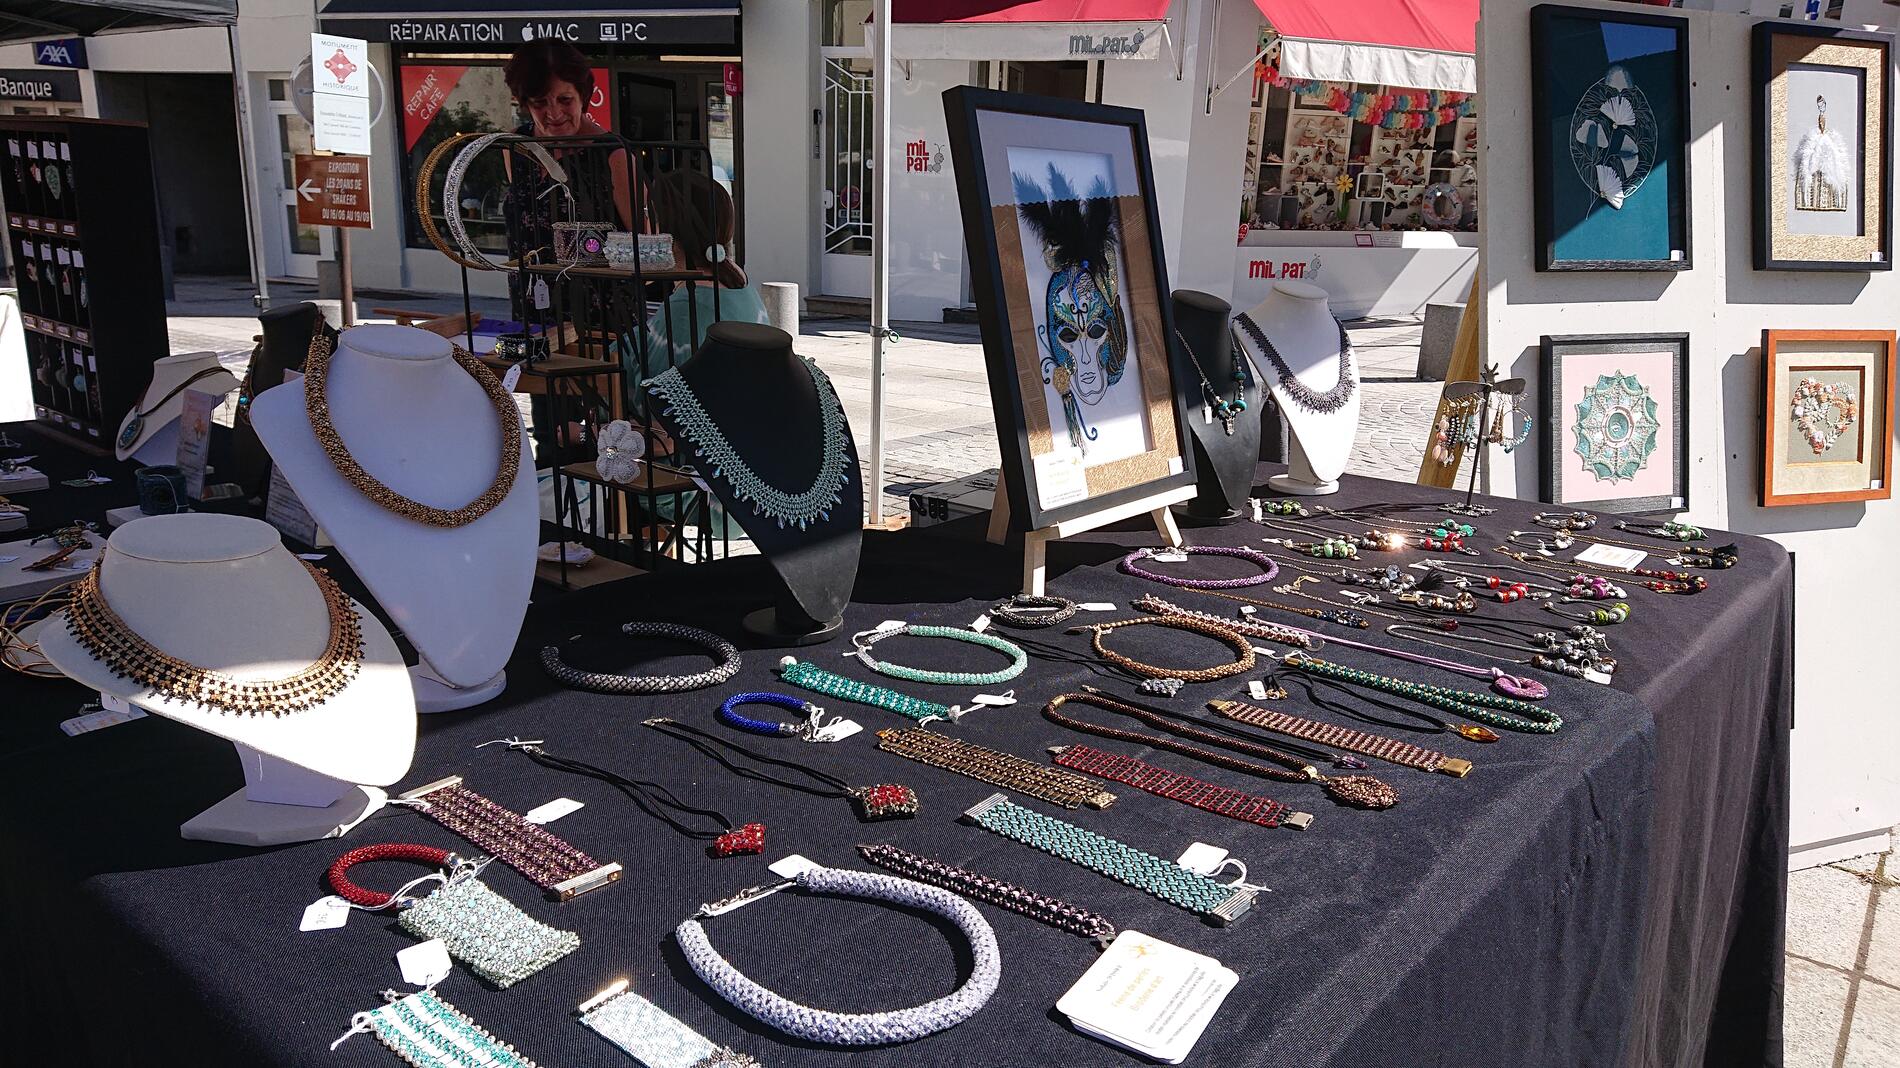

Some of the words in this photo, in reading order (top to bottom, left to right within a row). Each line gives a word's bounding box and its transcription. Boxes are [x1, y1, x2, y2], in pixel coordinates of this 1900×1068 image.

[390, 20, 503, 41] RÉPARATION
[538, 23, 579, 41] MAC
[622, 23, 648, 41] PC
[39, 45, 72, 64] AXA
[0, 77, 52, 100] Banque
[328, 162, 360, 174] EXPOSITION
[326, 177, 335, 188] LES
[343, 179, 353, 190] ANS
[354, 179, 362, 190] DE
[332, 193, 357, 206] SHAKERS
[322, 208, 330, 219] DU
[346, 210, 354, 221] AU
